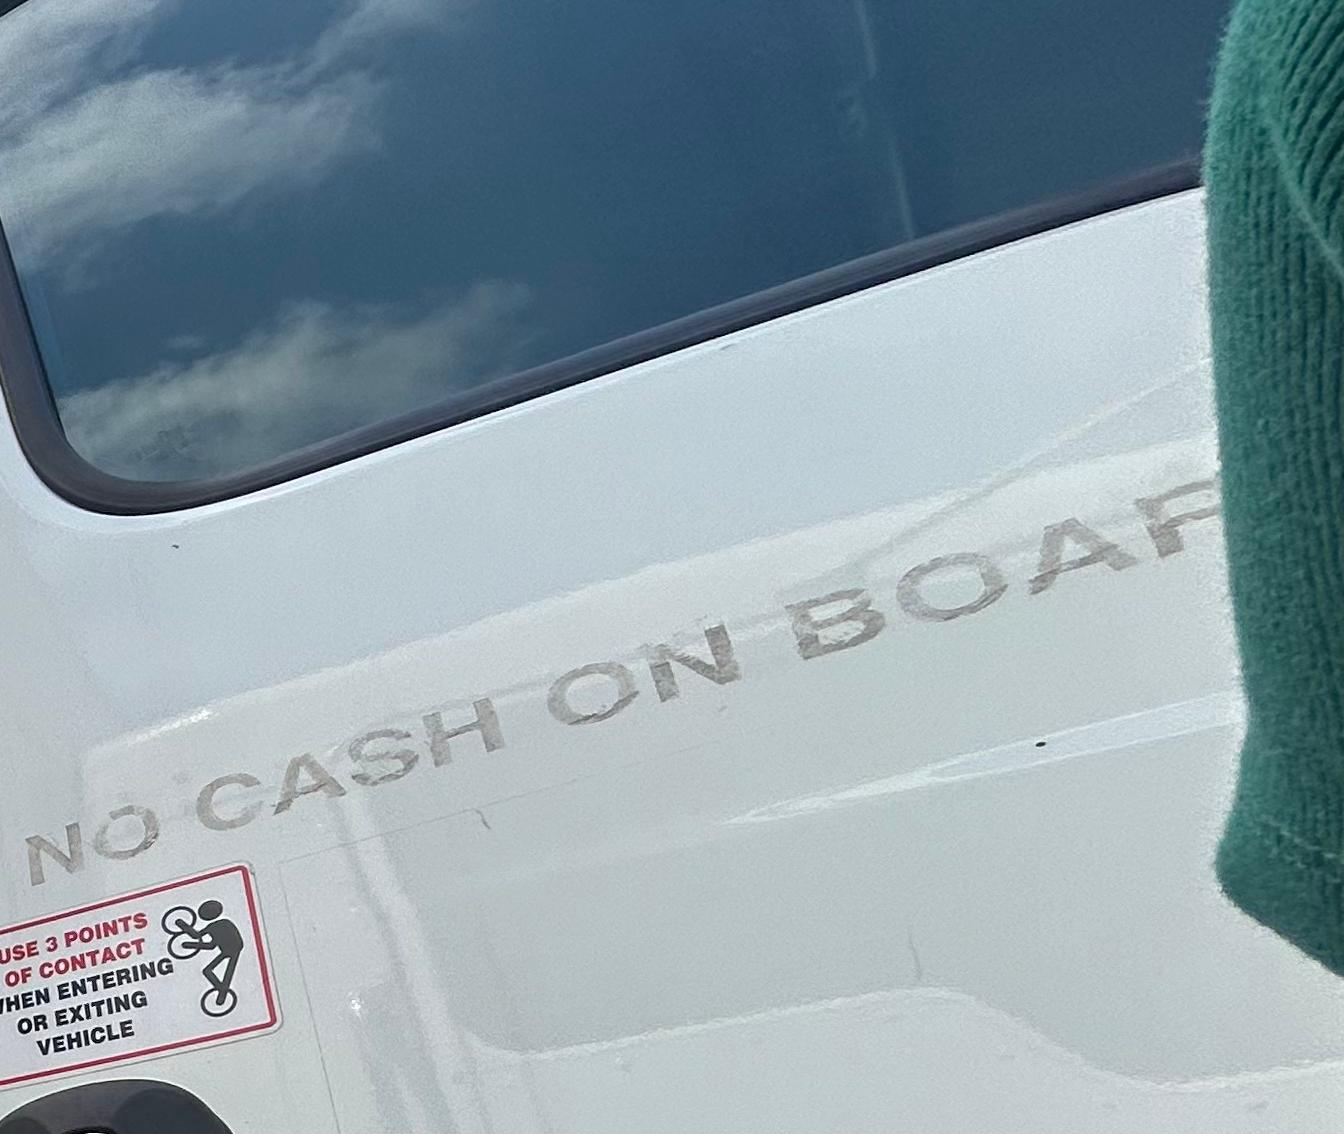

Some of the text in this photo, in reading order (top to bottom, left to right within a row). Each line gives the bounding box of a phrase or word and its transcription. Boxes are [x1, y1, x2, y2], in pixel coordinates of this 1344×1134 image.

[25, 804, 160, 887] NO
[195, 697, 506, 832] CASH
[546, 622, 743, 725] ON
[47, 937, 59, 954] 3
[64, 912, 148, 949] POINTS
[5, 938, 146, 988] OF CONTACT
[58, 957, 175, 1001] ENTERING
[16, 991, 148, 1035] OR EXITING
[36, 1020, 135, 1056] VEHICLE
